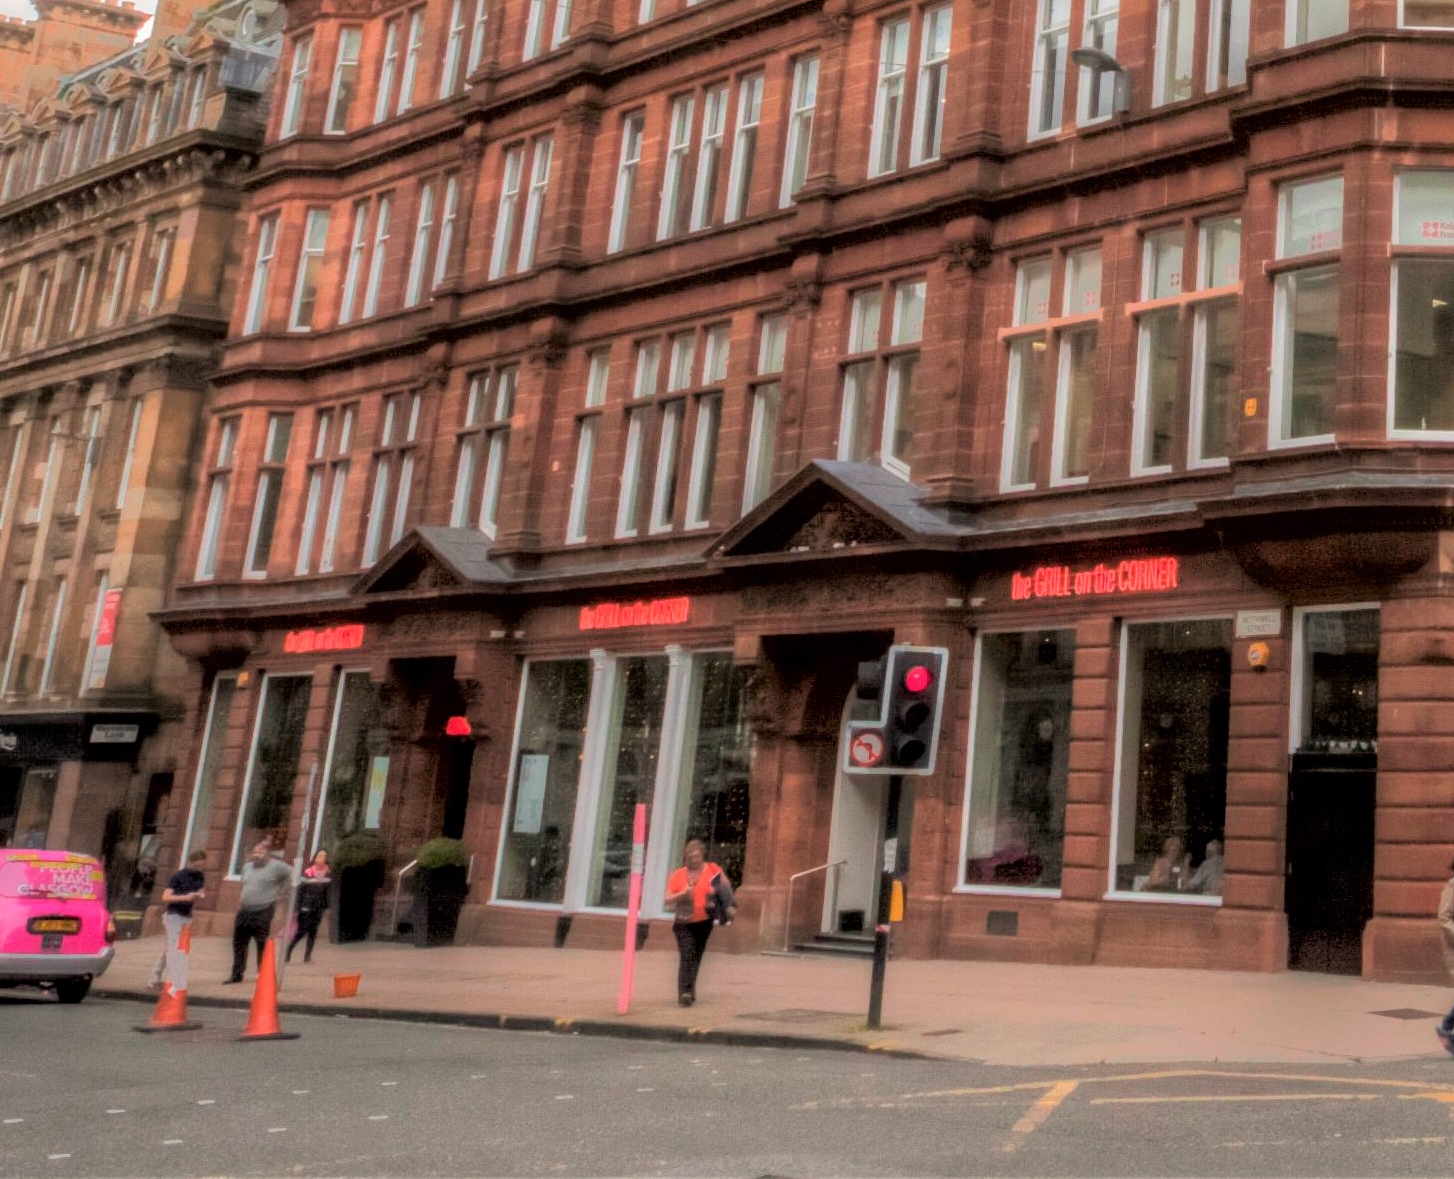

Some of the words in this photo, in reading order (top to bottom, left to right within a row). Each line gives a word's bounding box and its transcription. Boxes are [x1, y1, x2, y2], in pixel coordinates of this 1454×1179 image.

[1012, 571, 1031, 600] the
[1034, 566, 1071, 597] GRILL
[1074, 571, 1092, 595] on
[1093, 563, 1116, 594] the
[1117, 557, 1179, 591] CORNER
[53, 873, 93, 883] MAKE
[17, 883, 94, 895] GLASGOW
